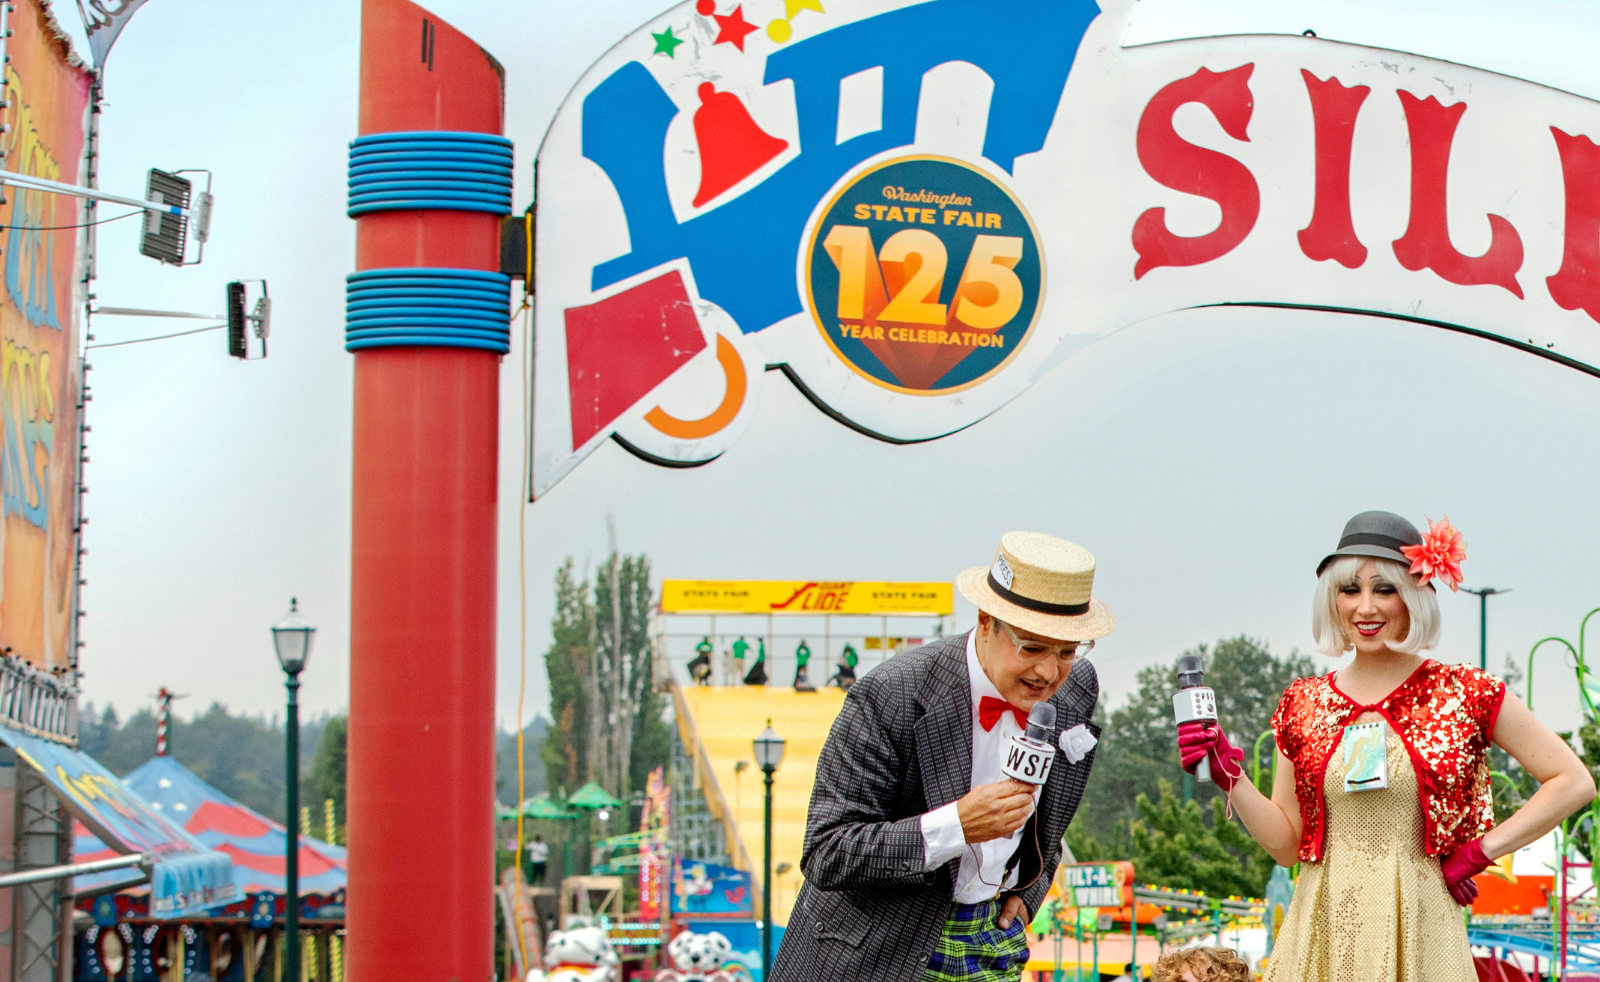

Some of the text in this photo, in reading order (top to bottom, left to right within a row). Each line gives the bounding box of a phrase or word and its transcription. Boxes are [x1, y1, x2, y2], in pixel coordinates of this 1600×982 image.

[882, 185, 973, 209] Washington
[854, 203, 1002, 229] STATE FAIR
[822, 224, 1024, 330] 125
[838, 323, 1004, 348] YEAR CELEBRATION
[1075, 887, 1120, 907] WHIRL
